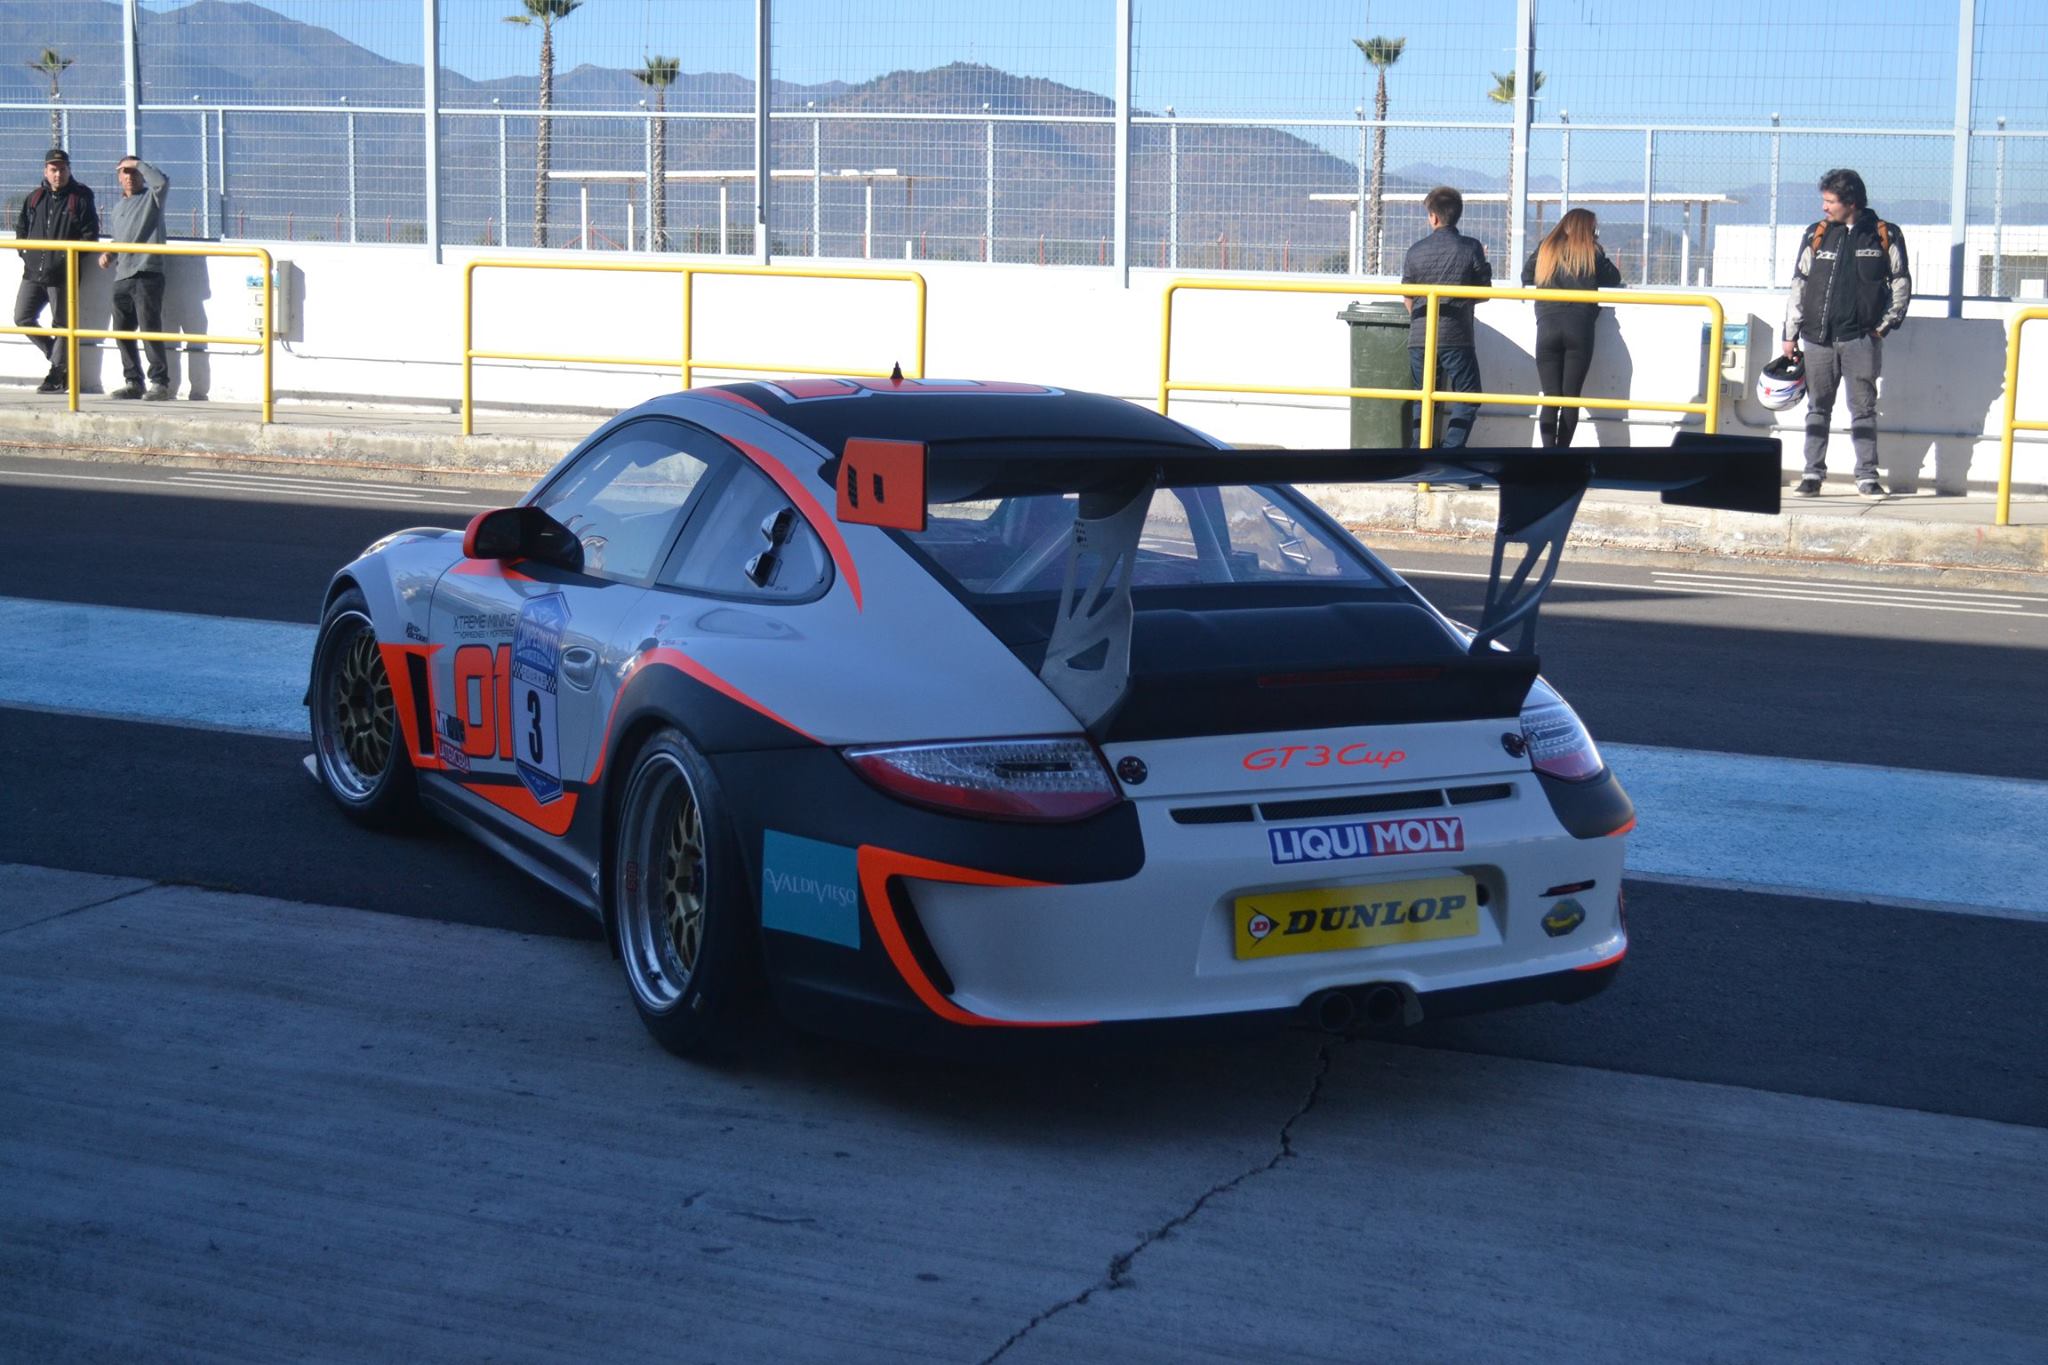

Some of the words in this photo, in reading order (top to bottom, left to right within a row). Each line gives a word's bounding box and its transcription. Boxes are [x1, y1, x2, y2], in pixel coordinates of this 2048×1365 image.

[526, 690, 544, 764] 3
[1336, 743, 1407, 769] Cup
[1272, 828, 1370, 862] LIQUI
[1373, 818, 1462, 853] MOLY
[1283, 895, 1466, 936] DUNLOP
